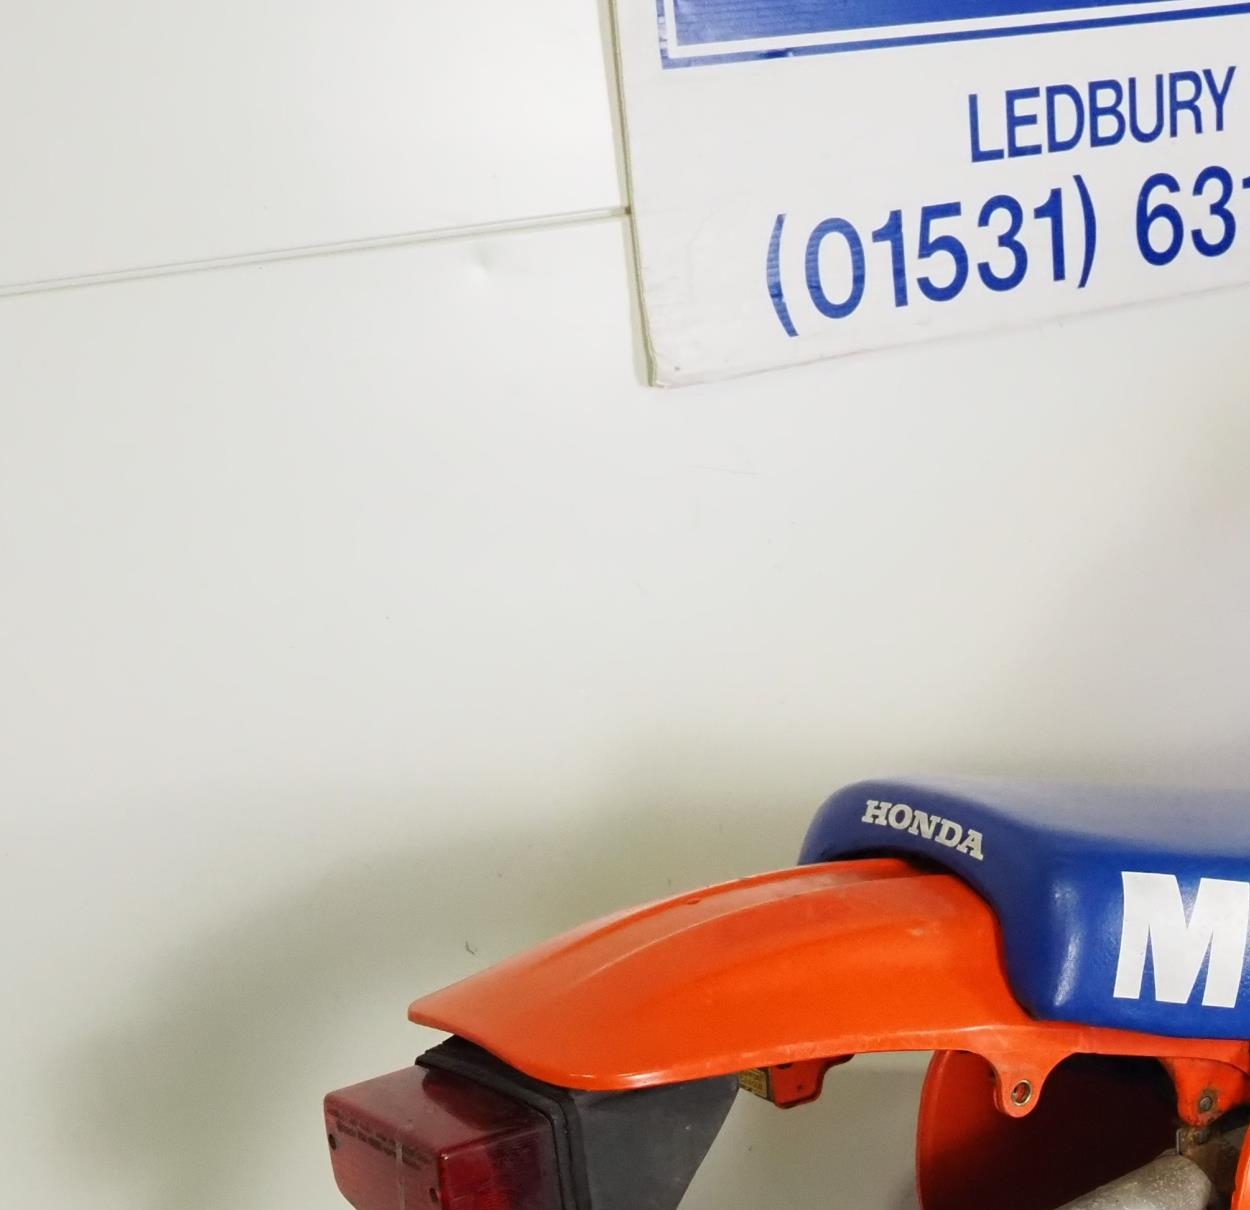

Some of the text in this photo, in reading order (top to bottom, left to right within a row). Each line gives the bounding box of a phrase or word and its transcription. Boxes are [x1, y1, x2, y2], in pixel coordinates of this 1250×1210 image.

[968, 66, 1236, 162] LEDBURY
[766, 174, 1097, 337] (01531)
[861, 799, 984, 861] HONDA
